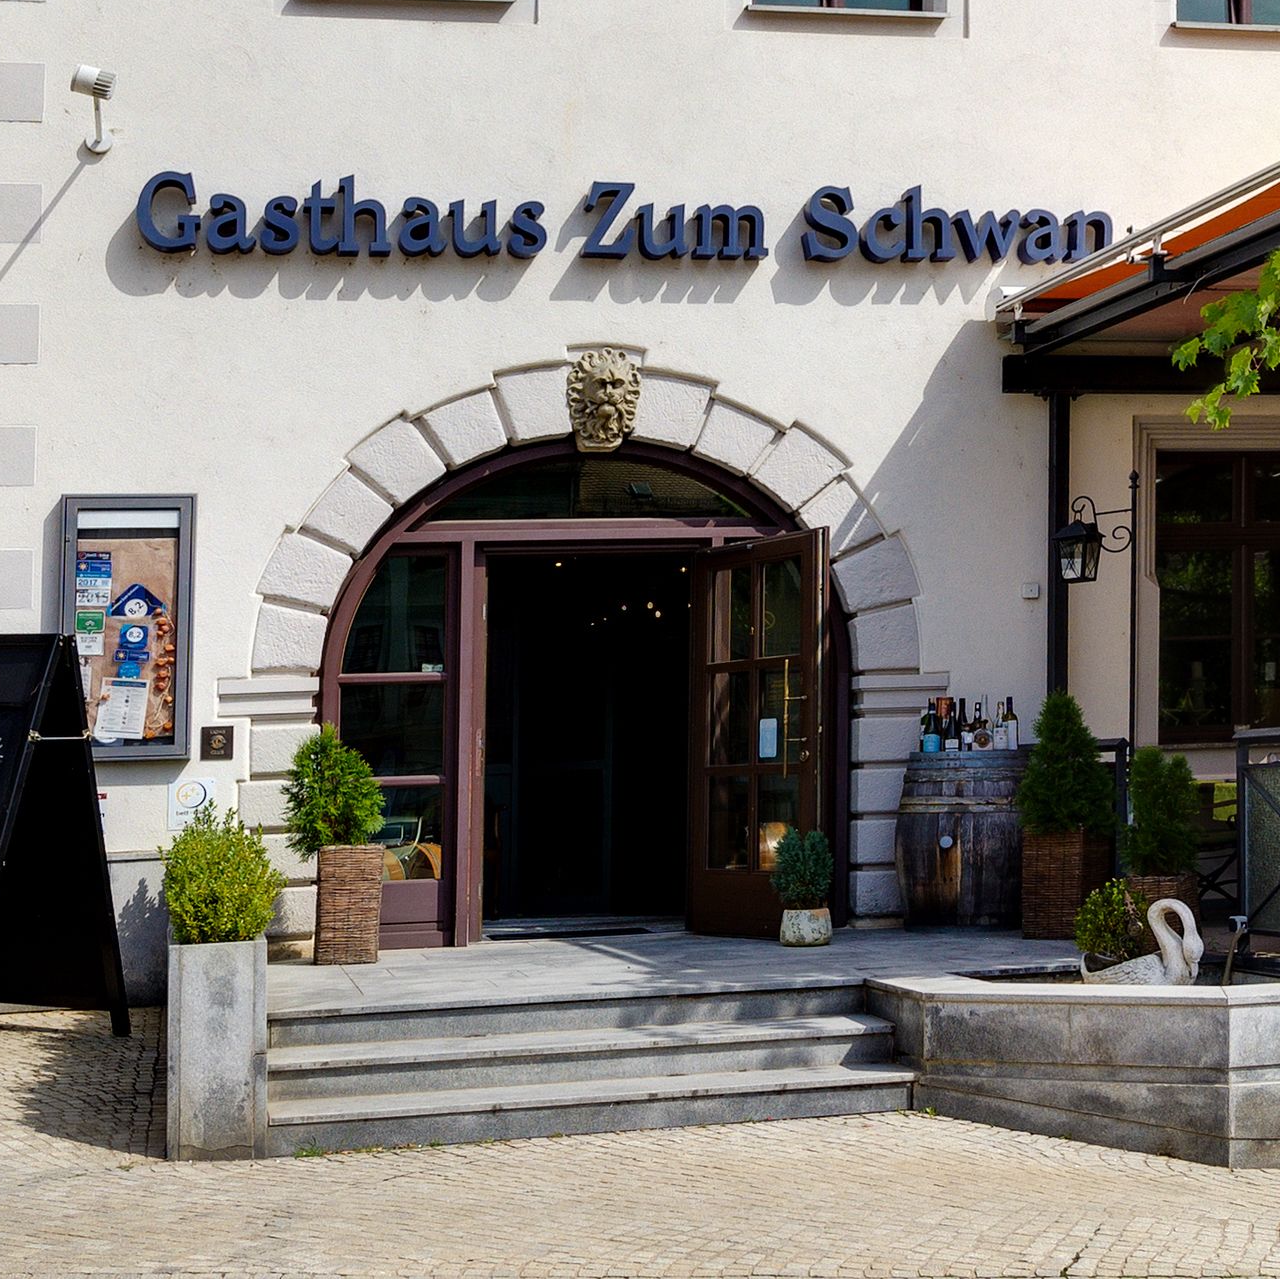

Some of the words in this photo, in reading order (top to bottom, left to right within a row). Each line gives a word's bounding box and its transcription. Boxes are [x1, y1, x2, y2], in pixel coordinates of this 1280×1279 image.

[136, 170, 549, 259] Gasthaus
[579, 180, 769, 261] Zum
[801, 184, 1114, 265] Schwan
